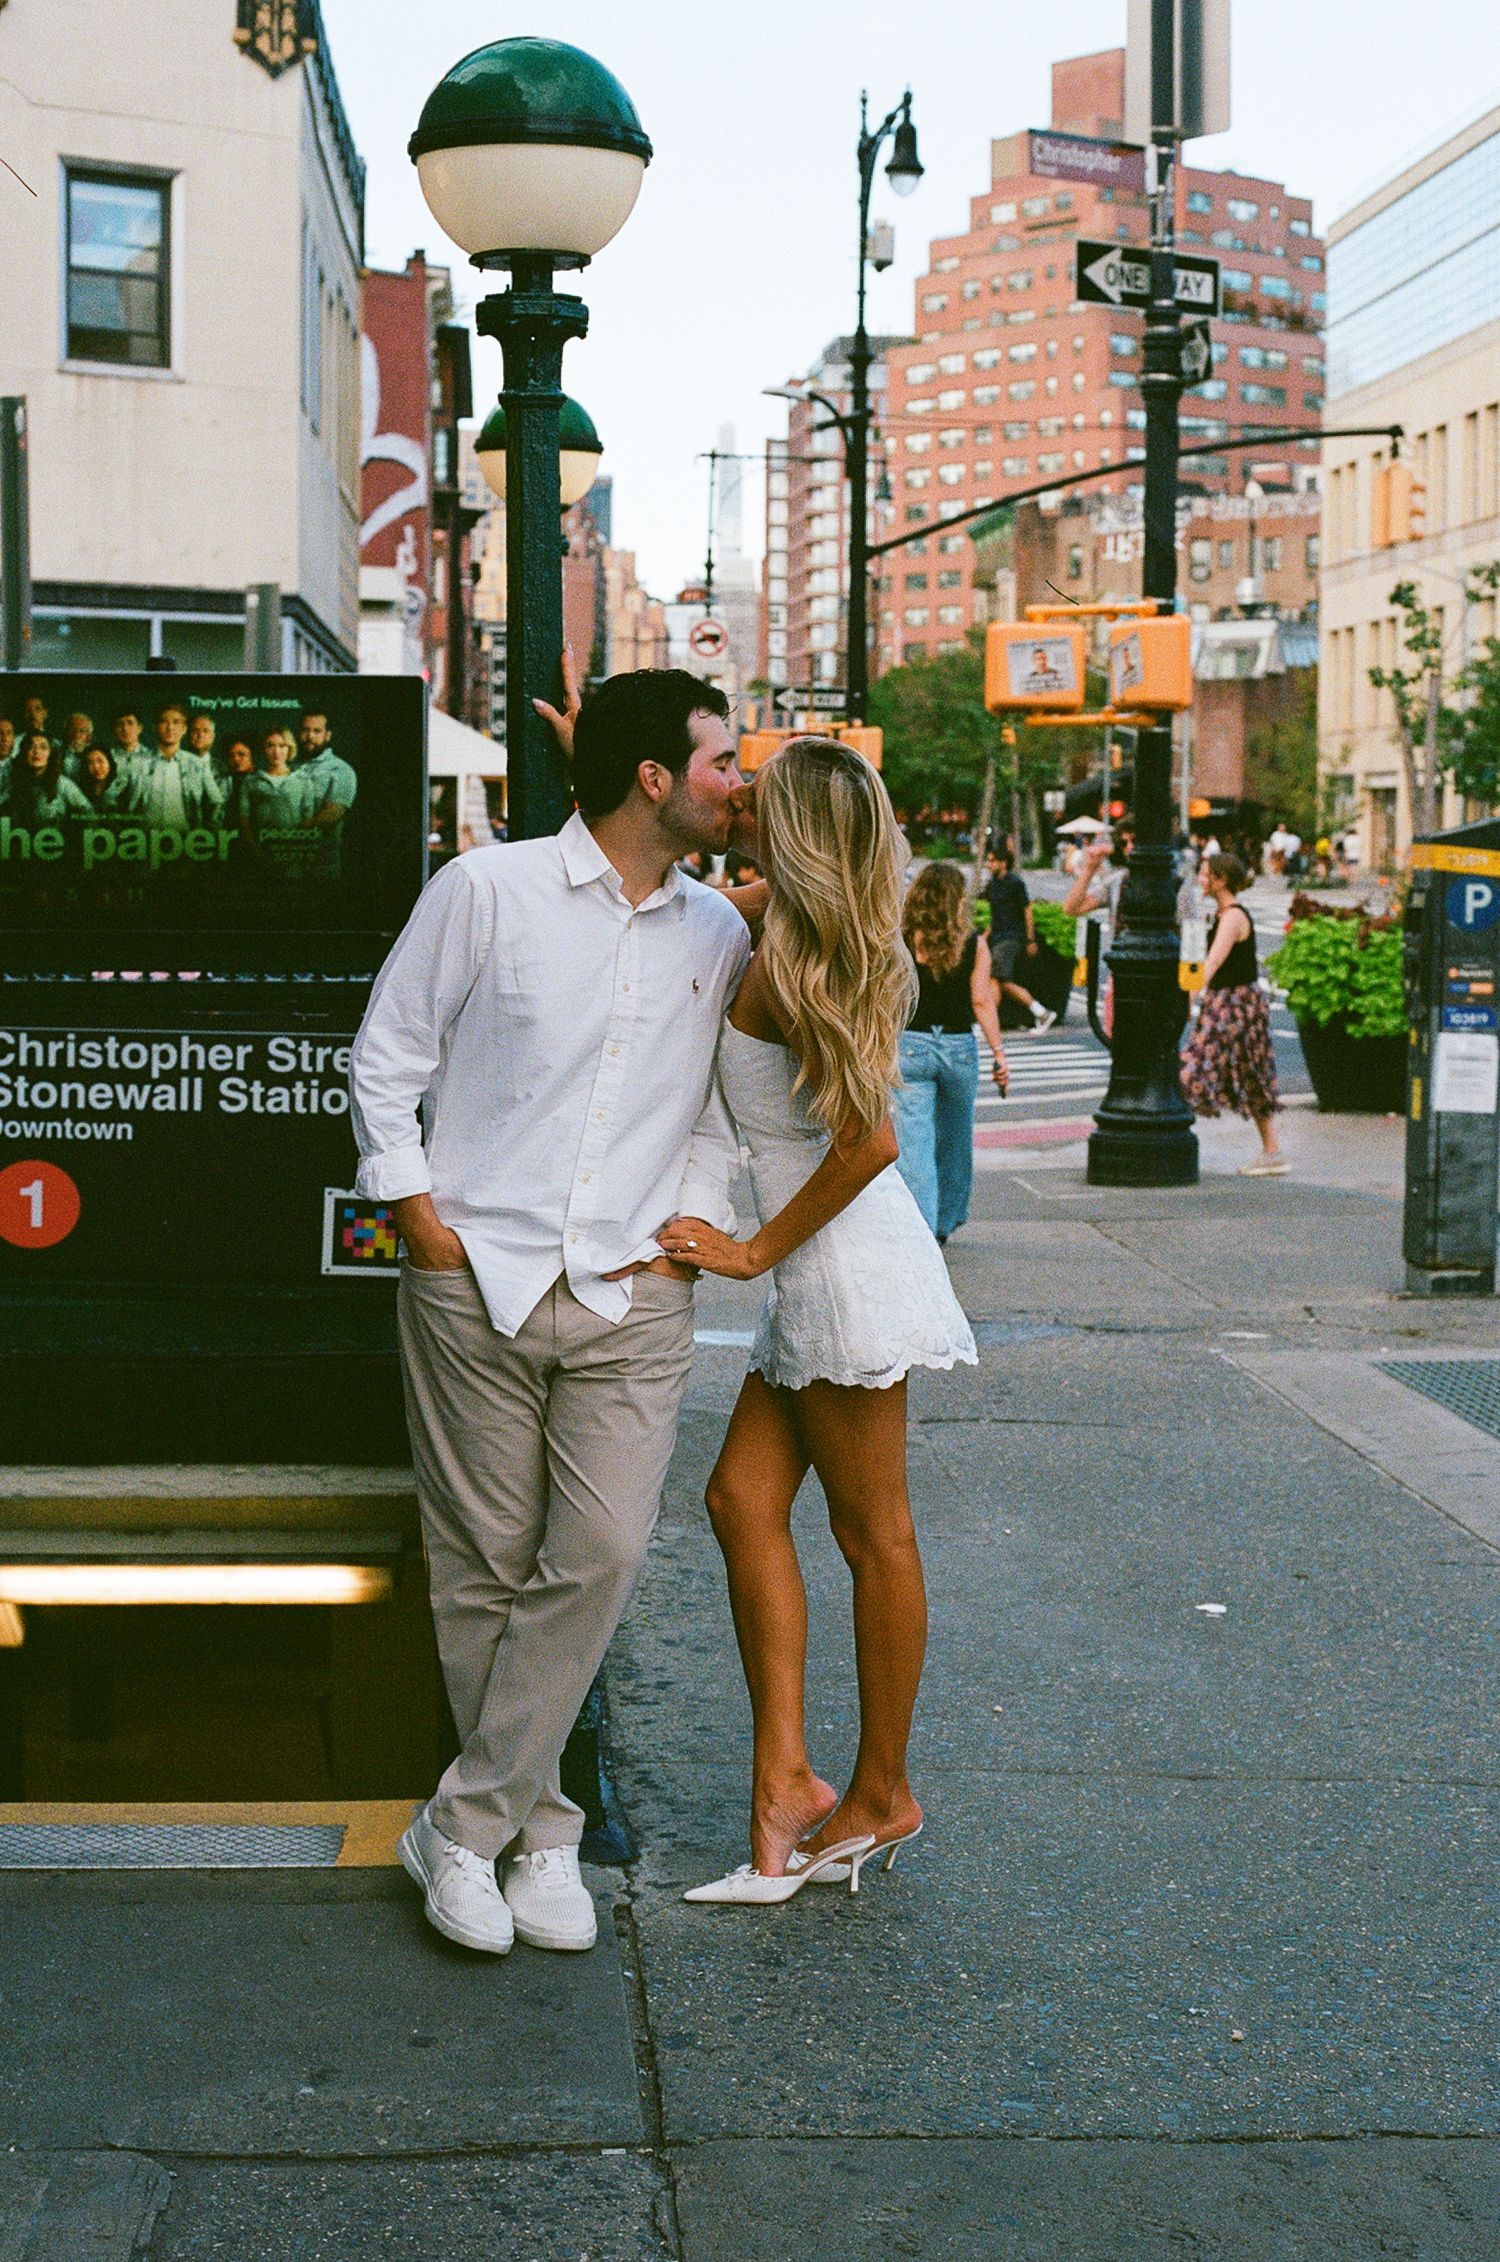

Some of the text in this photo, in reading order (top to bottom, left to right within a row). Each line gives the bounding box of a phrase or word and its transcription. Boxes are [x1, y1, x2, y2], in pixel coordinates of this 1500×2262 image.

[1104, 262, 1206, 297] ONE AY
[190, 696, 302, 711] They've Got Issues.
[0, 816, 66, 861] he
[83, 827, 239, 870] paper
[1465, 883, 1493, 924] P
[0, 1032, 351, 1078] Christopher Stre
[0, 1072, 349, 1115] Stonewall Statio
[0, 1117, 133, 1140] owntown
[19, 1180, 44, 1228] 1
